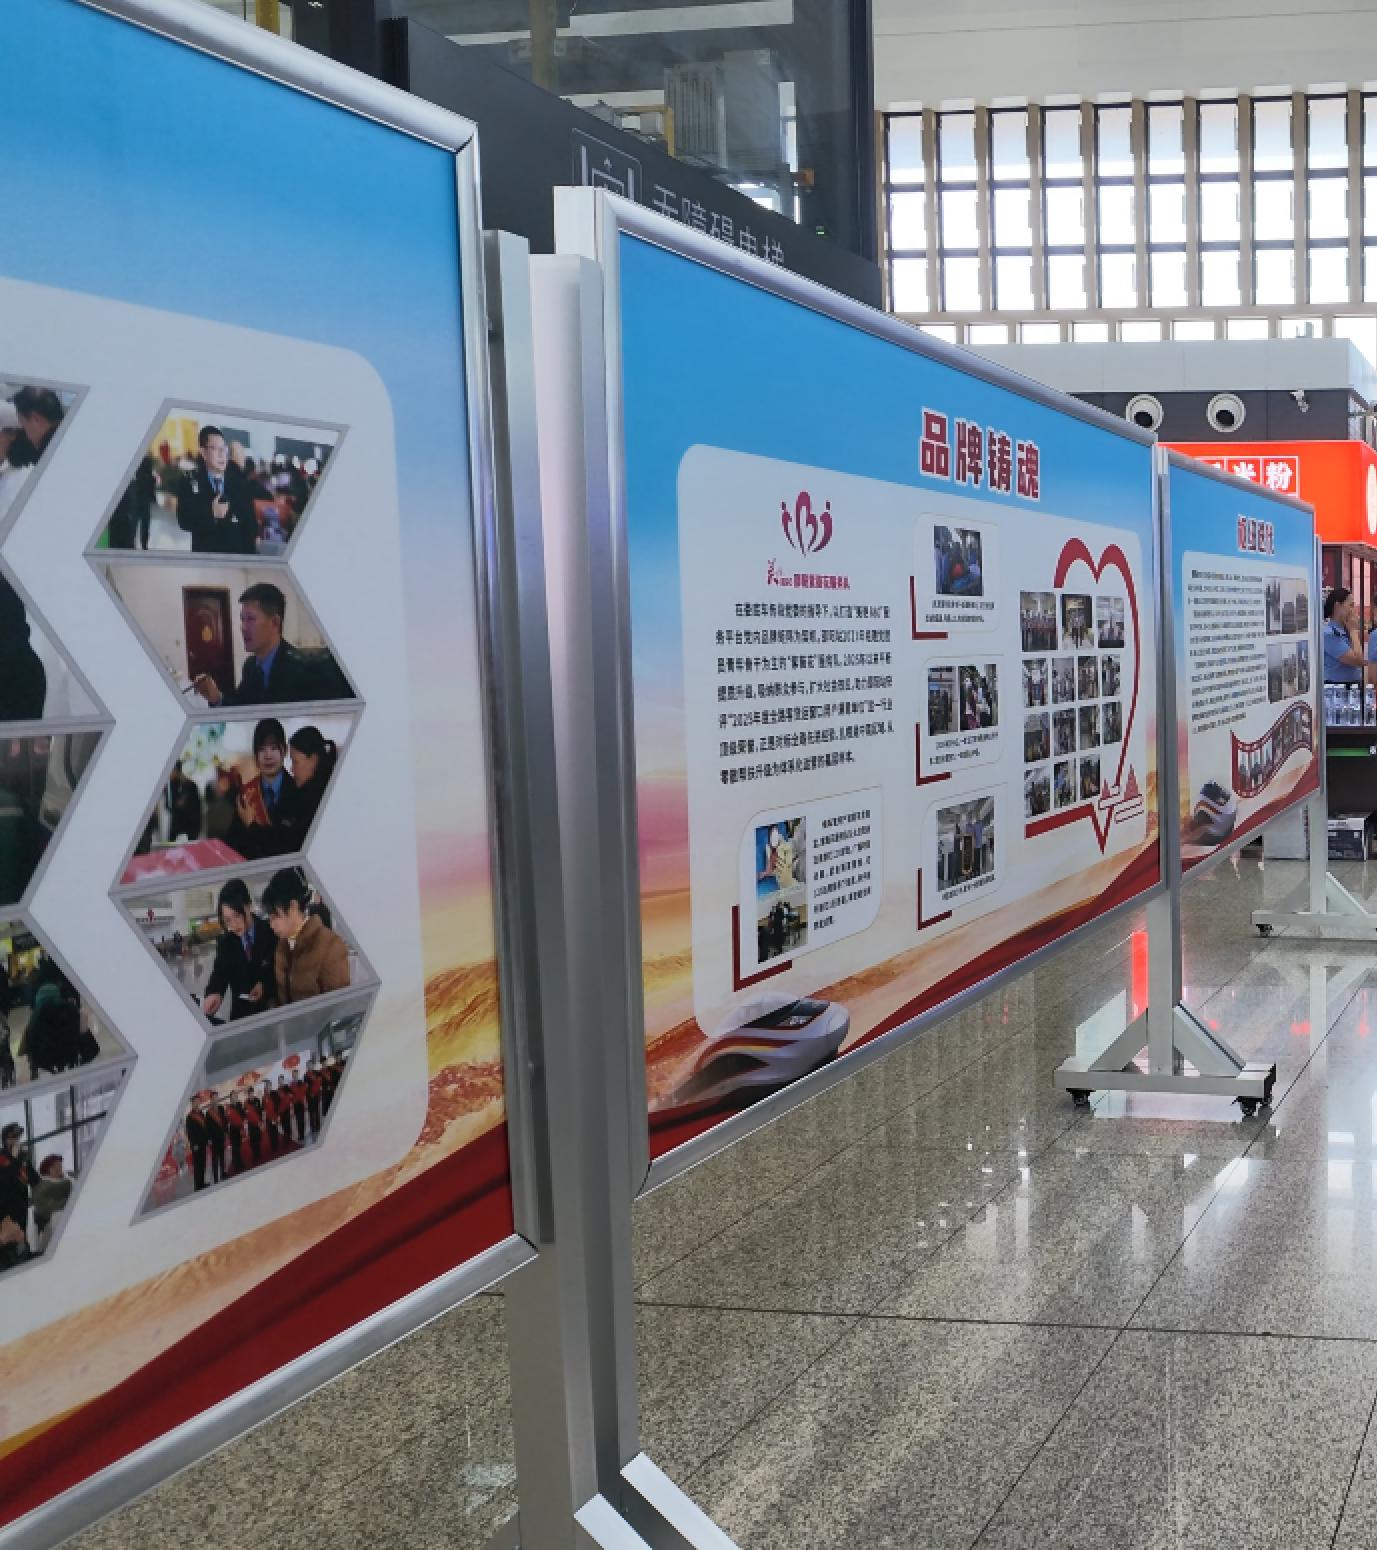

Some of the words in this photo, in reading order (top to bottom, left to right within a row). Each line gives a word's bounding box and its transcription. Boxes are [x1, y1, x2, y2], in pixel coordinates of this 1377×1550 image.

[920, 406, 1040, 502] 品牌铸魂
[1212, 461, 1293, 491] 米粉
